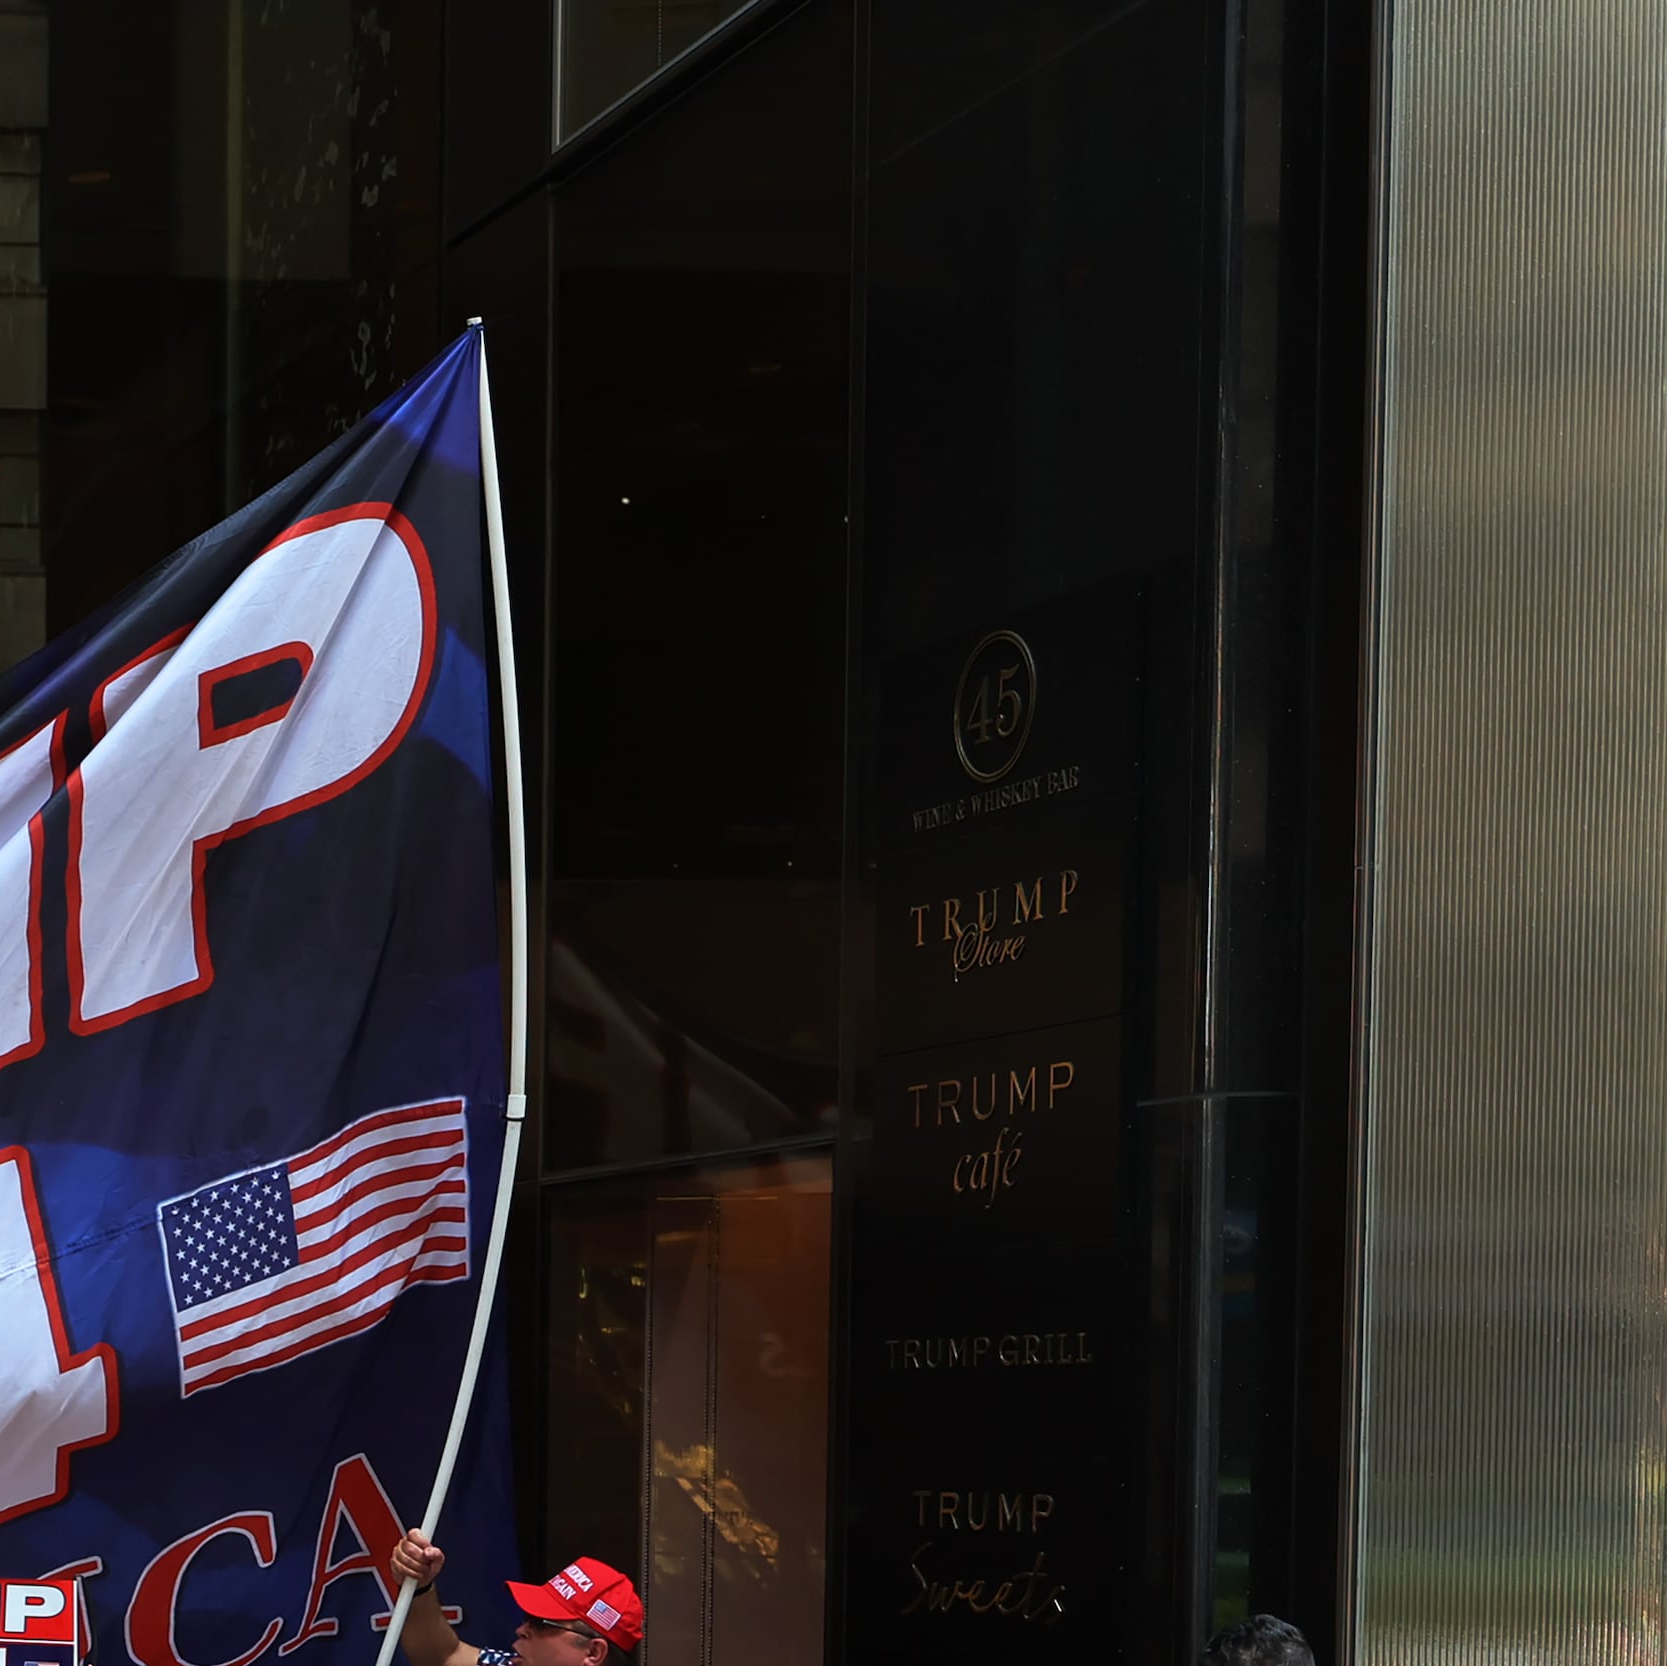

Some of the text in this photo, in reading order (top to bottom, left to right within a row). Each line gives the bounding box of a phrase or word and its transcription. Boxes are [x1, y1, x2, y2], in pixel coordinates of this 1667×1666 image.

[967, 664, 1022, 745] 45
[912, 766, 1080, 832] WINE & WHISKEY BAR
[909, 869, 1079, 947] TRUMP
[952, 920, 1026, 982] Store
[907, 1061, 1075, 1127] TRUMP
[952, 1126, 1023, 1209] café
[884, 1331, 1092, 1369] TRUMP GRILL
[912, 1489, 1055, 1533] TRUMP
[899, 1541, 1067, 1624] Sweets
